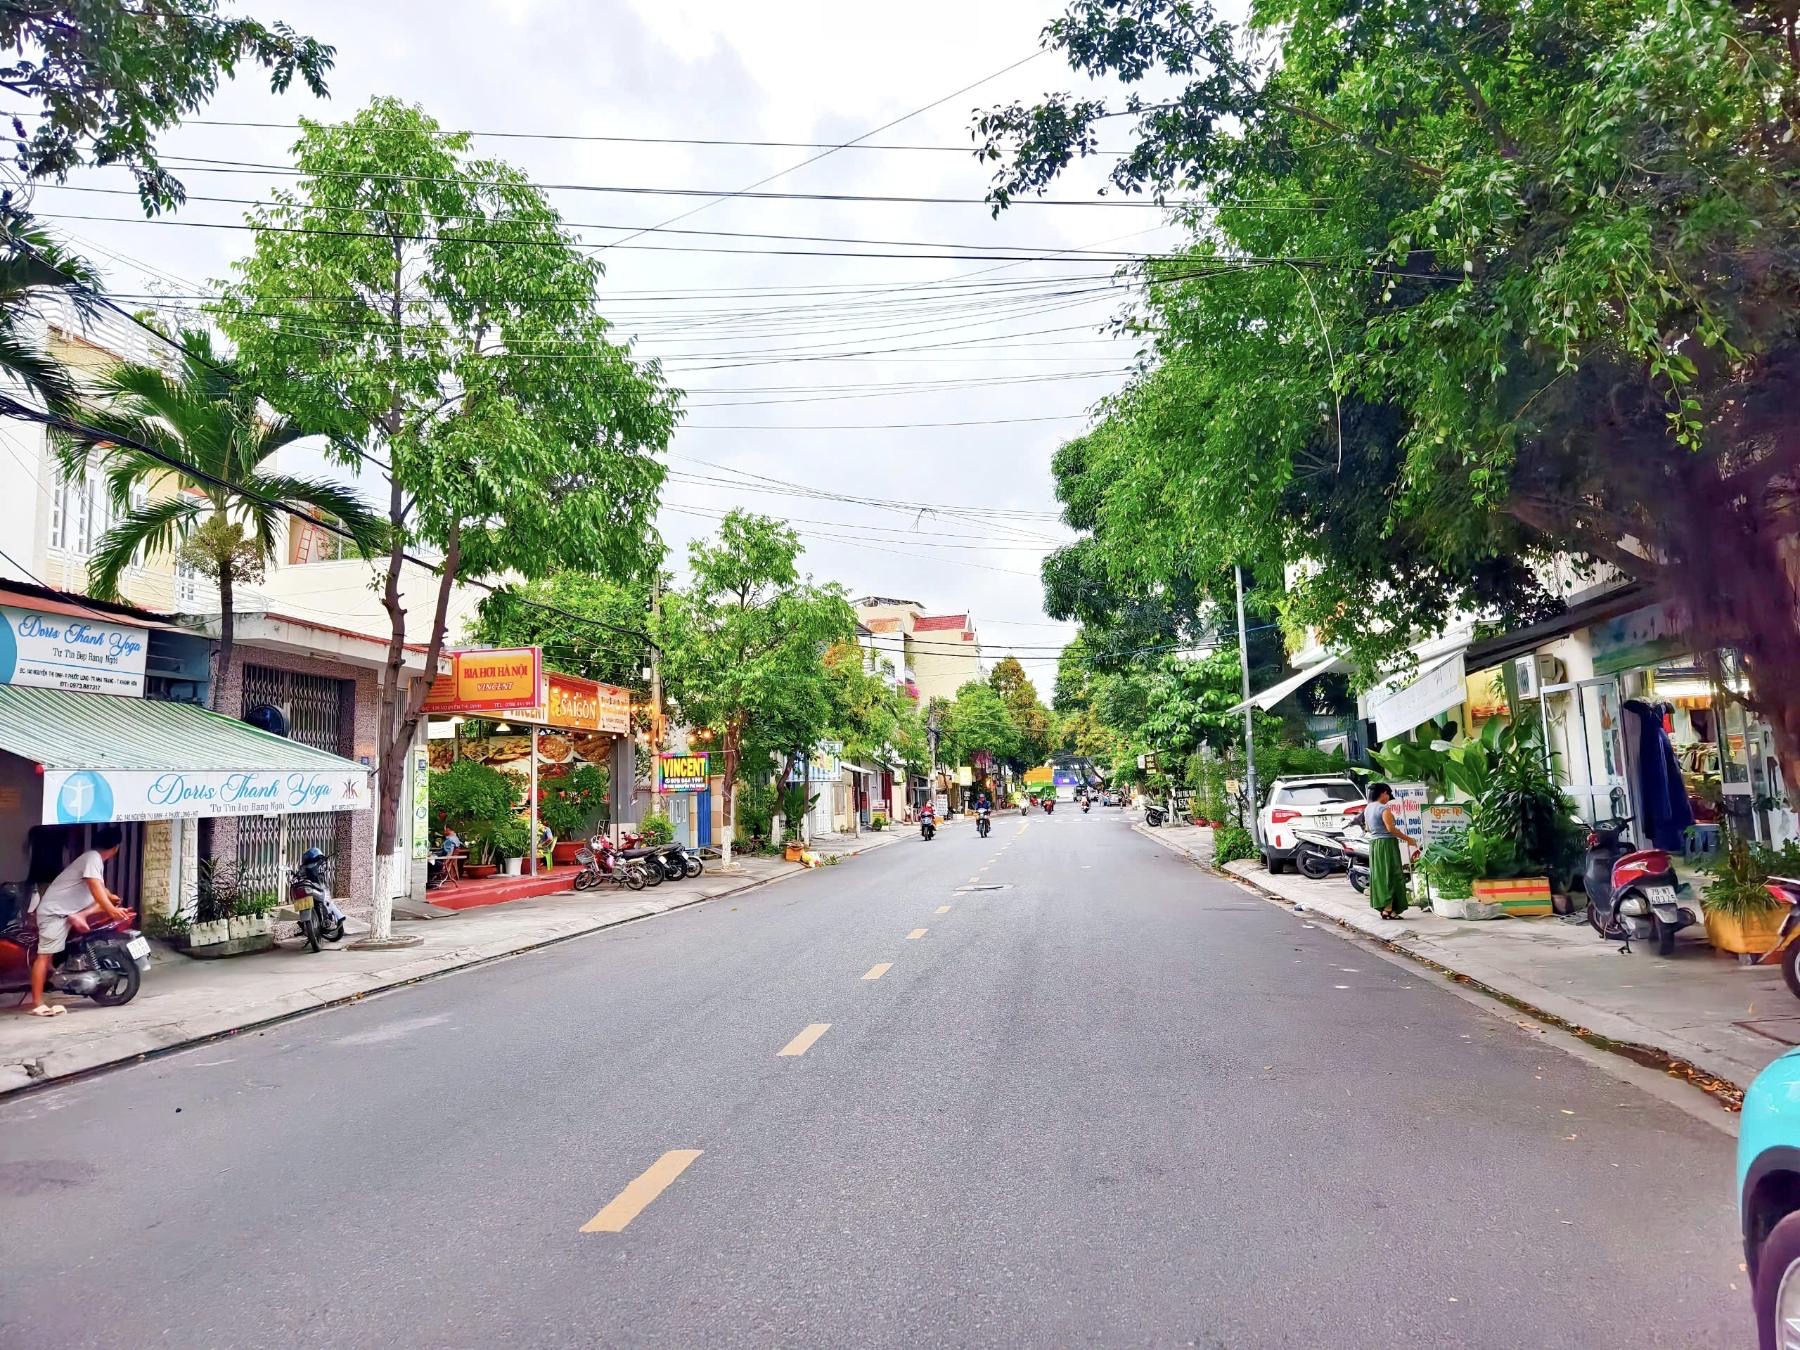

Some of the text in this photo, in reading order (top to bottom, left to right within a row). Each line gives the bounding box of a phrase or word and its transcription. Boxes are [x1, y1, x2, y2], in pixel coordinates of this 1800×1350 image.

[18, 614, 142, 657] Doris Thanh Yoga
[464, 668, 478, 679] BIA
[664, 757, 706, 777] VINCENT
[147, 773, 332, 807] Doris Thanh Yoga
